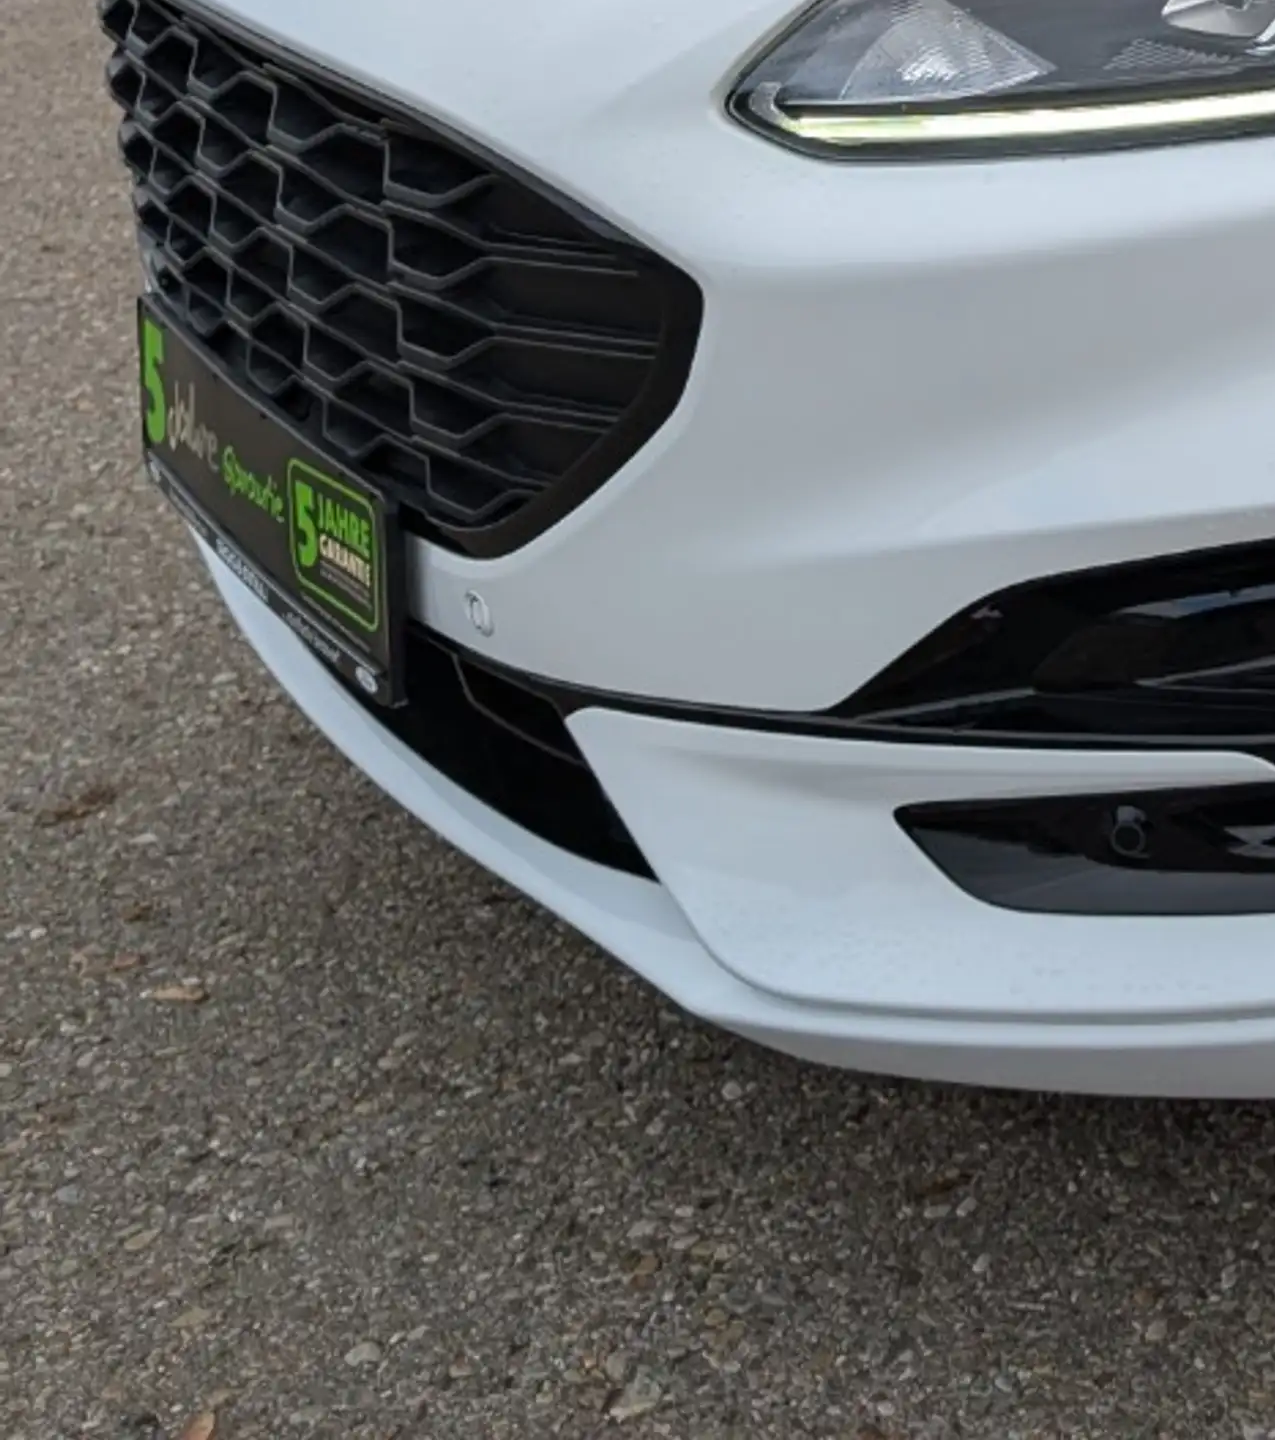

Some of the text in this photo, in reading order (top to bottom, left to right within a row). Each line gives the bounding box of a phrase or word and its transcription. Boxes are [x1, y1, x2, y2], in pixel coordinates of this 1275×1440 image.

[144, 319, 166, 443] 5
[295, 479, 318, 568] 5
[316, 492, 371, 559] JAHRE
